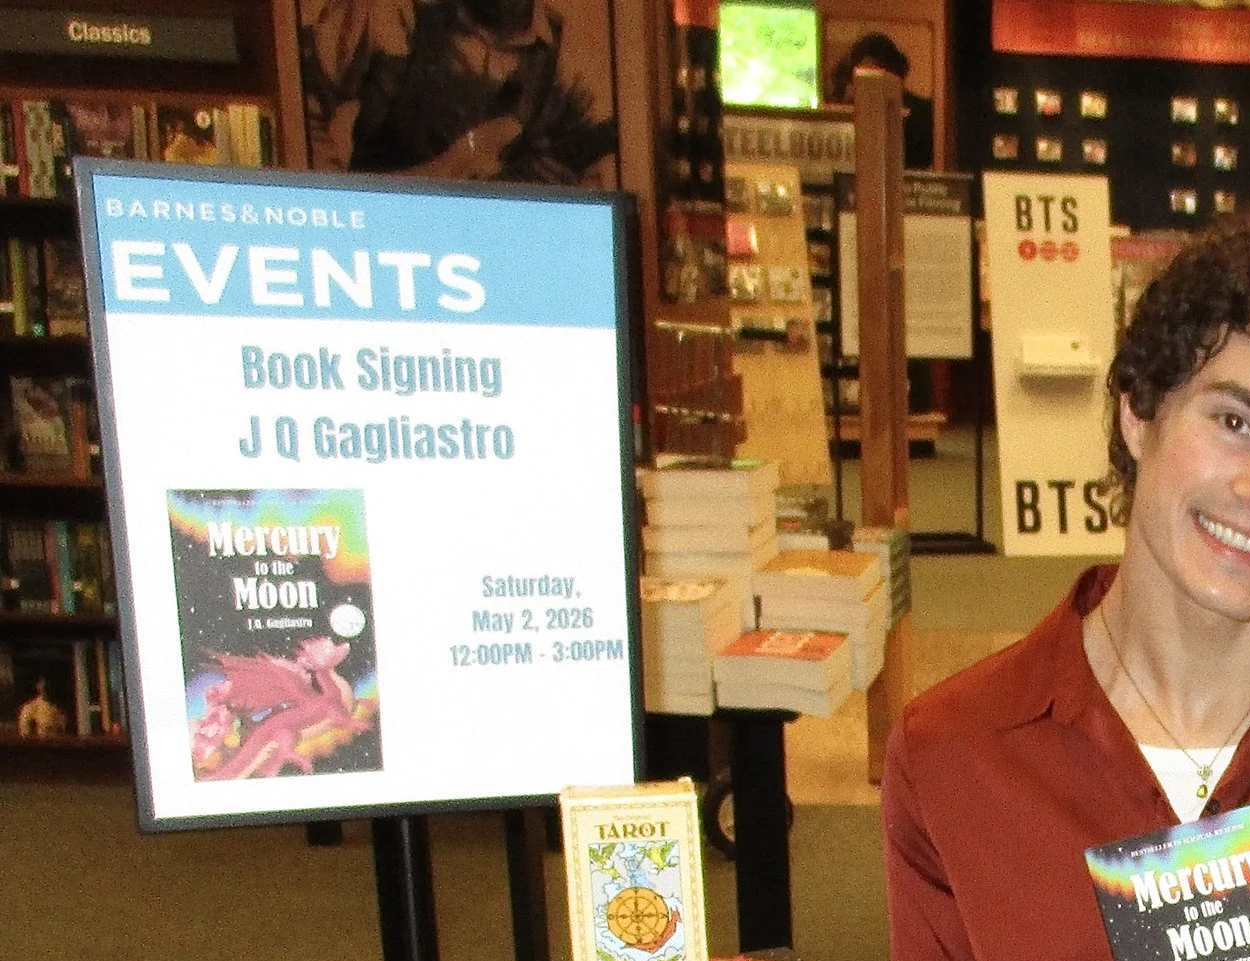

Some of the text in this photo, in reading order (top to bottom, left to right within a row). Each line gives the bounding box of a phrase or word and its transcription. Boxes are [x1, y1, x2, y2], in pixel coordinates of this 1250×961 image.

[67, 21, 151, 45] Classics
[105, 197, 366, 229] BARNES&NOBLE
[1015, 194, 1078, 234] BTS
[111, 239, 486, 313] EVENTS
[241, 344, 502, 398] Book Signing
[239, 415, 515, 464] J Q Gagliastro
[1015, 479, 1109, 534] BTS
[206, 521, 340, 559] Mercury
[254, 560, 294, 576] to the
[233, 577, 318, 610] Moon
[482, 574, 582, 599] Saturday,
[472, 607, 594, 634] May 2, 2026
[449, 642, 533, 667] 12:00PM
[552, 638, 624, 663] 3:00PM
[594, 820, 670, 840] TAROT
[1183, 900, 1224, 922] to the
